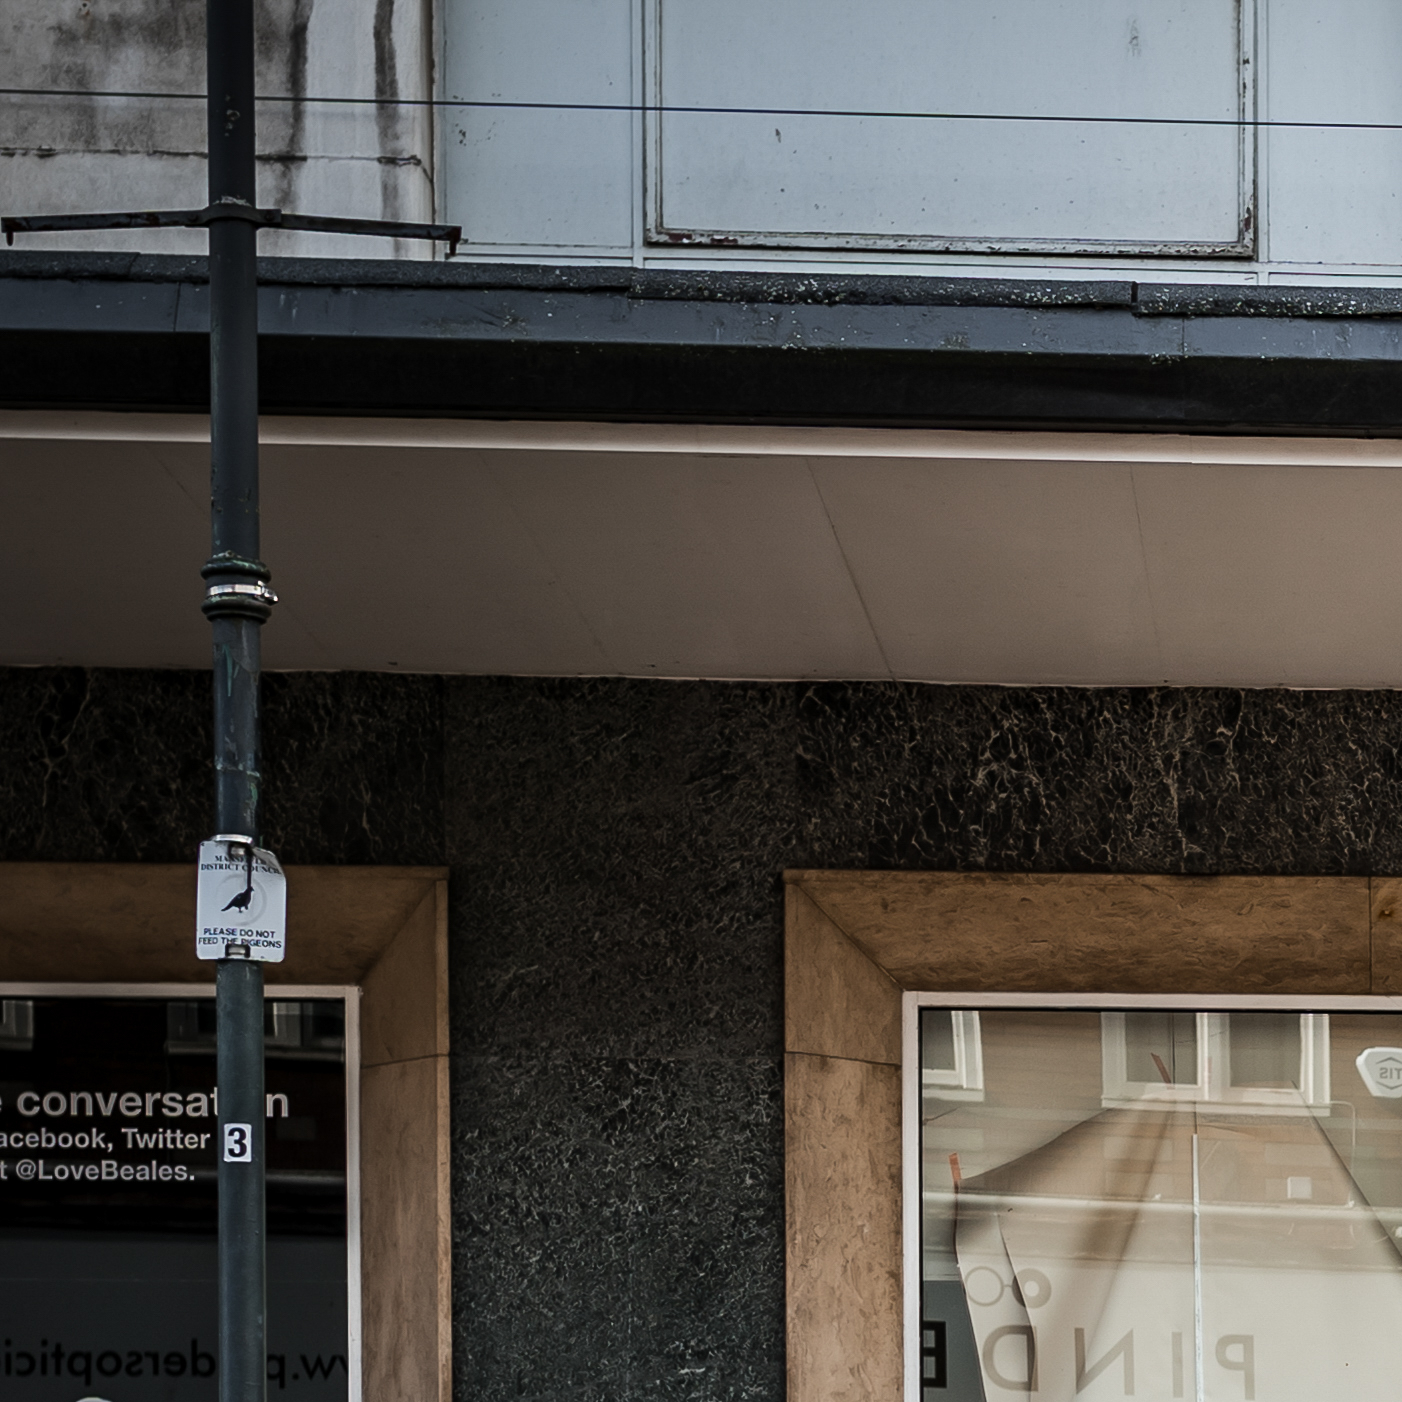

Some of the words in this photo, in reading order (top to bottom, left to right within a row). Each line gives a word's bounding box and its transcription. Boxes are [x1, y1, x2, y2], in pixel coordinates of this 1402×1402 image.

[200, 863, 239, 872] DISTRICT
[198, 936, 218, 945] FEED
[221, 937, 238, 945] THE
[240, 938, 282, 949] PIGEONS
[203, 927, 238, 936] PLEASE
[239, 928, 254, 937] DO
[255, 930, 276, 939] NOT
[16, 1086, 290, 1118] conversatn
[121, 1128, 211, 1150] Twitter
[226, 1127, 248, 1158] 3
[15, 1160, 196, 1181] @LoveBeales.
